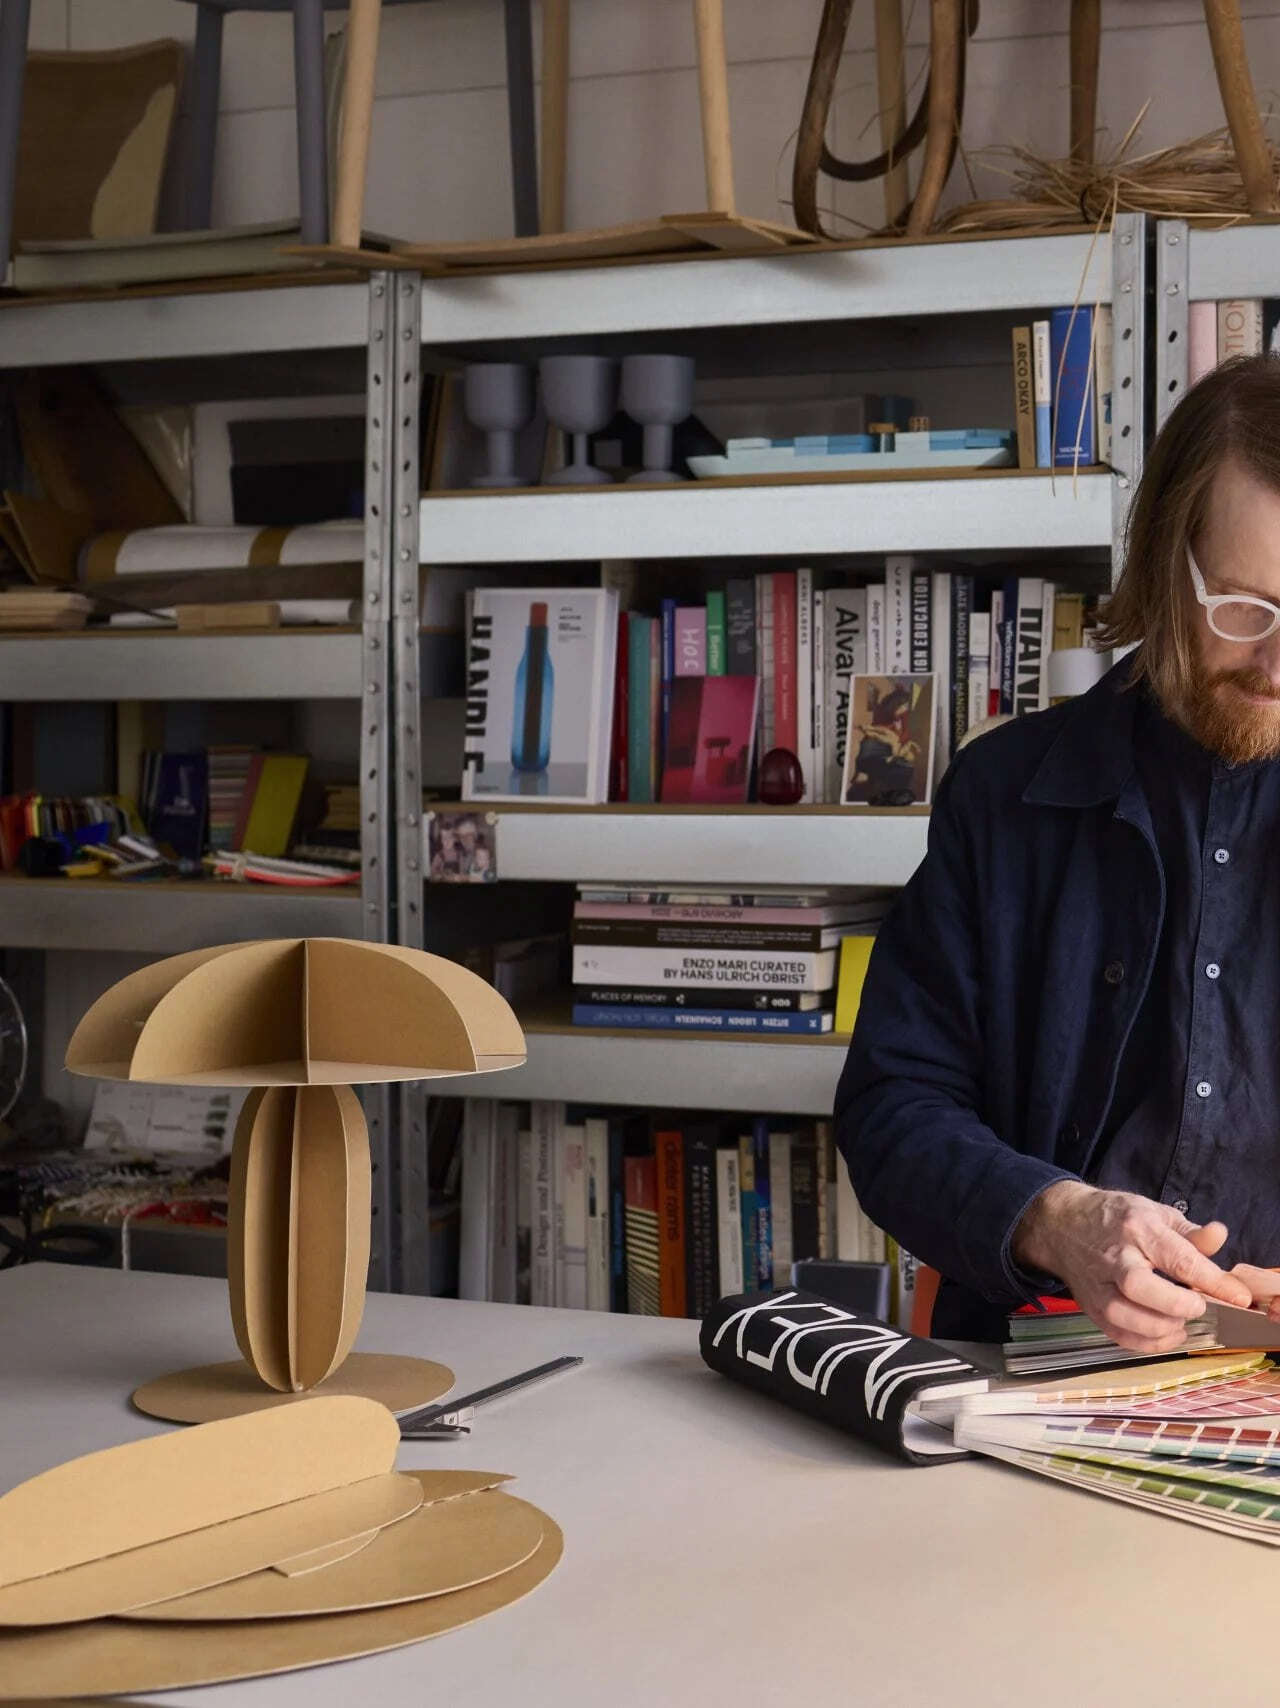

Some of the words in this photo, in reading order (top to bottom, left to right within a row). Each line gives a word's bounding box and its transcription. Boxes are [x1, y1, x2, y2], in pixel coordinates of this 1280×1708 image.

[1016, 342, 1028, 376] ARCO
[1018, 380, 1029, 415] OKAY
[957, 584, 967, 608] TATE
[914, 576, 928, 646] EDUCATION
[835, 607, 859, 679] Alvar
[957, 612, 967, 657] MODERN
[956, 660, 966, 678] THE
[664, 968, 679, 980] BY
[680, 969, 714, 981] HANS
[716, 970, 760, 983] ULRICH
[763, 971, 807, 985] OBRIST
[683, 957, 715, 970] ENZO
[717, 959, 748, 972] MARI
[750, 960, 806, 973] CURATED
[591, 992, 620, 1002] PLACES
[621, 993, 632, 1002] OF
[633, 993, 668, 1003] MEMORY
